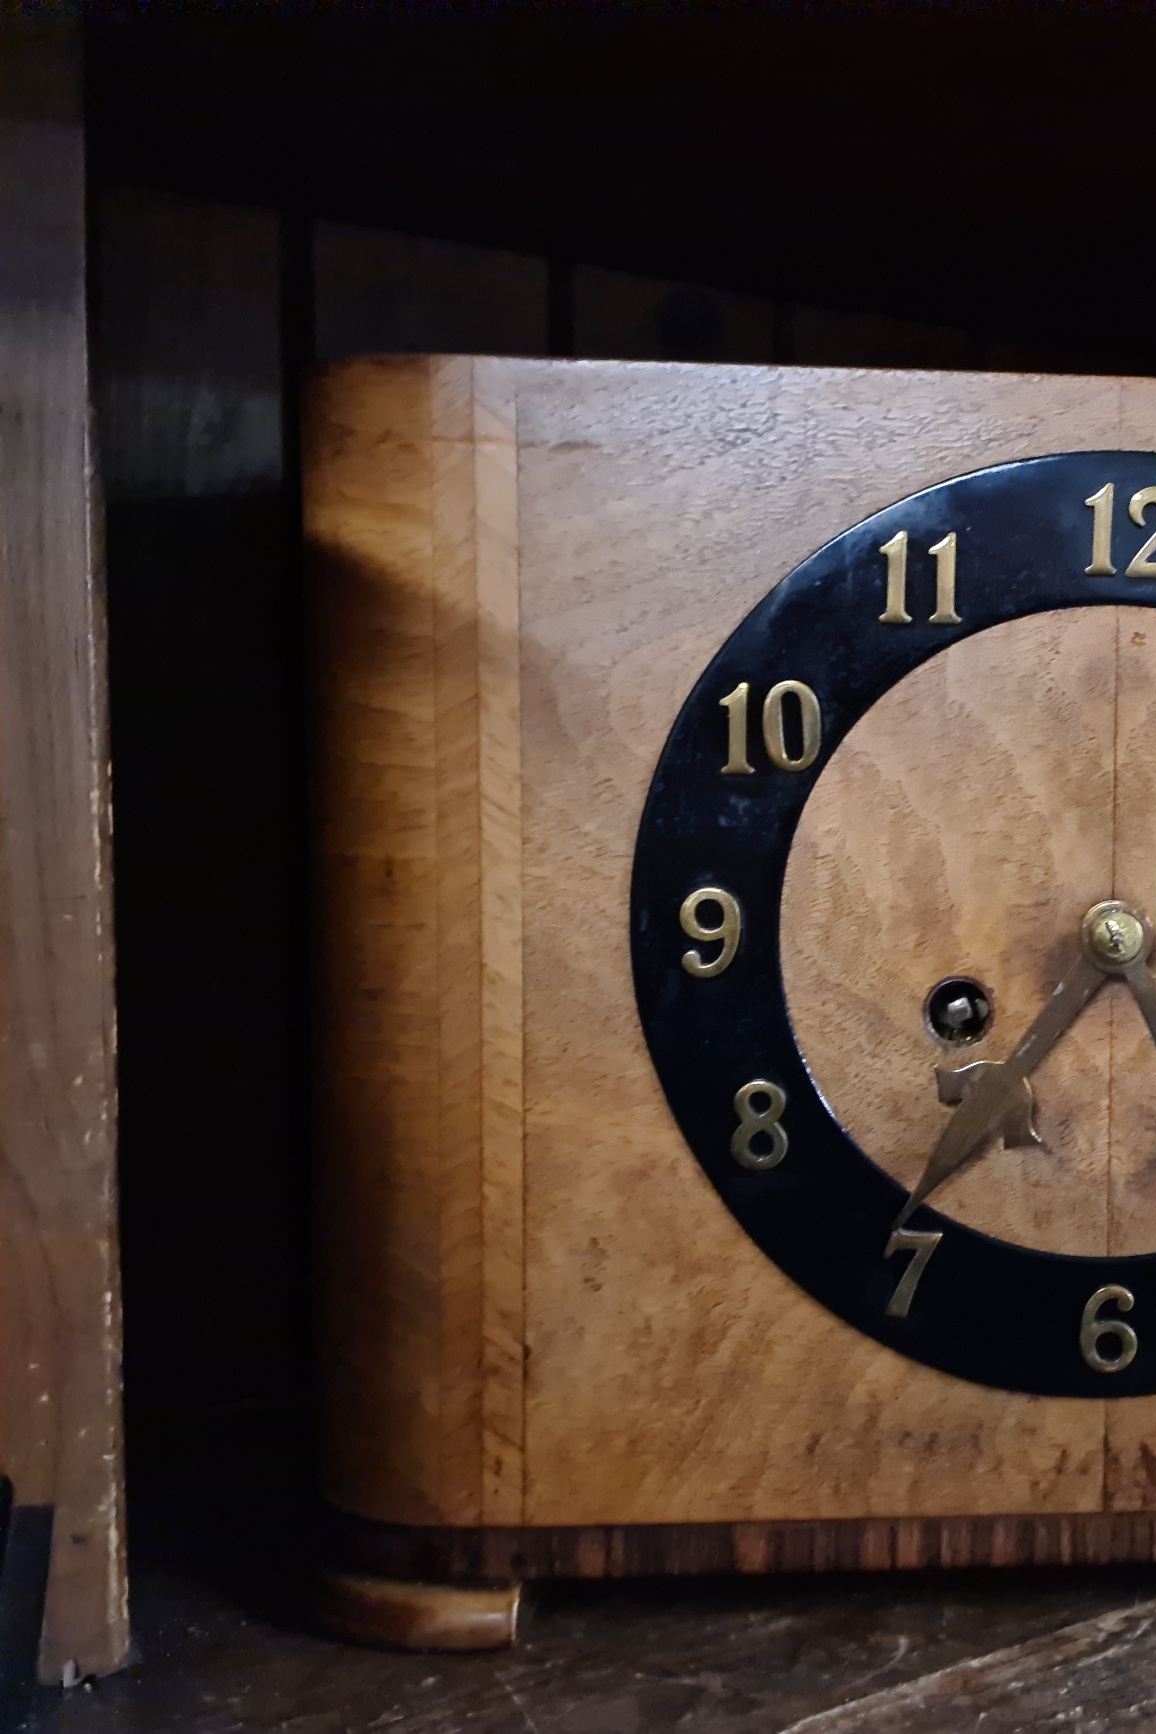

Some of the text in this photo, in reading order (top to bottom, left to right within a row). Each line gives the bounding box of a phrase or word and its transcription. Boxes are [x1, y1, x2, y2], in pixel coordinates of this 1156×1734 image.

[878, 530, 963, 625] 11
[718, 679, 821, 775] 10
[679, 886, 740, 978] 9
[730, 1078, 789, 1170] 8
[884, 1230, 943, 1317] 7
[1079, 1284, 1138, 1373] 6
